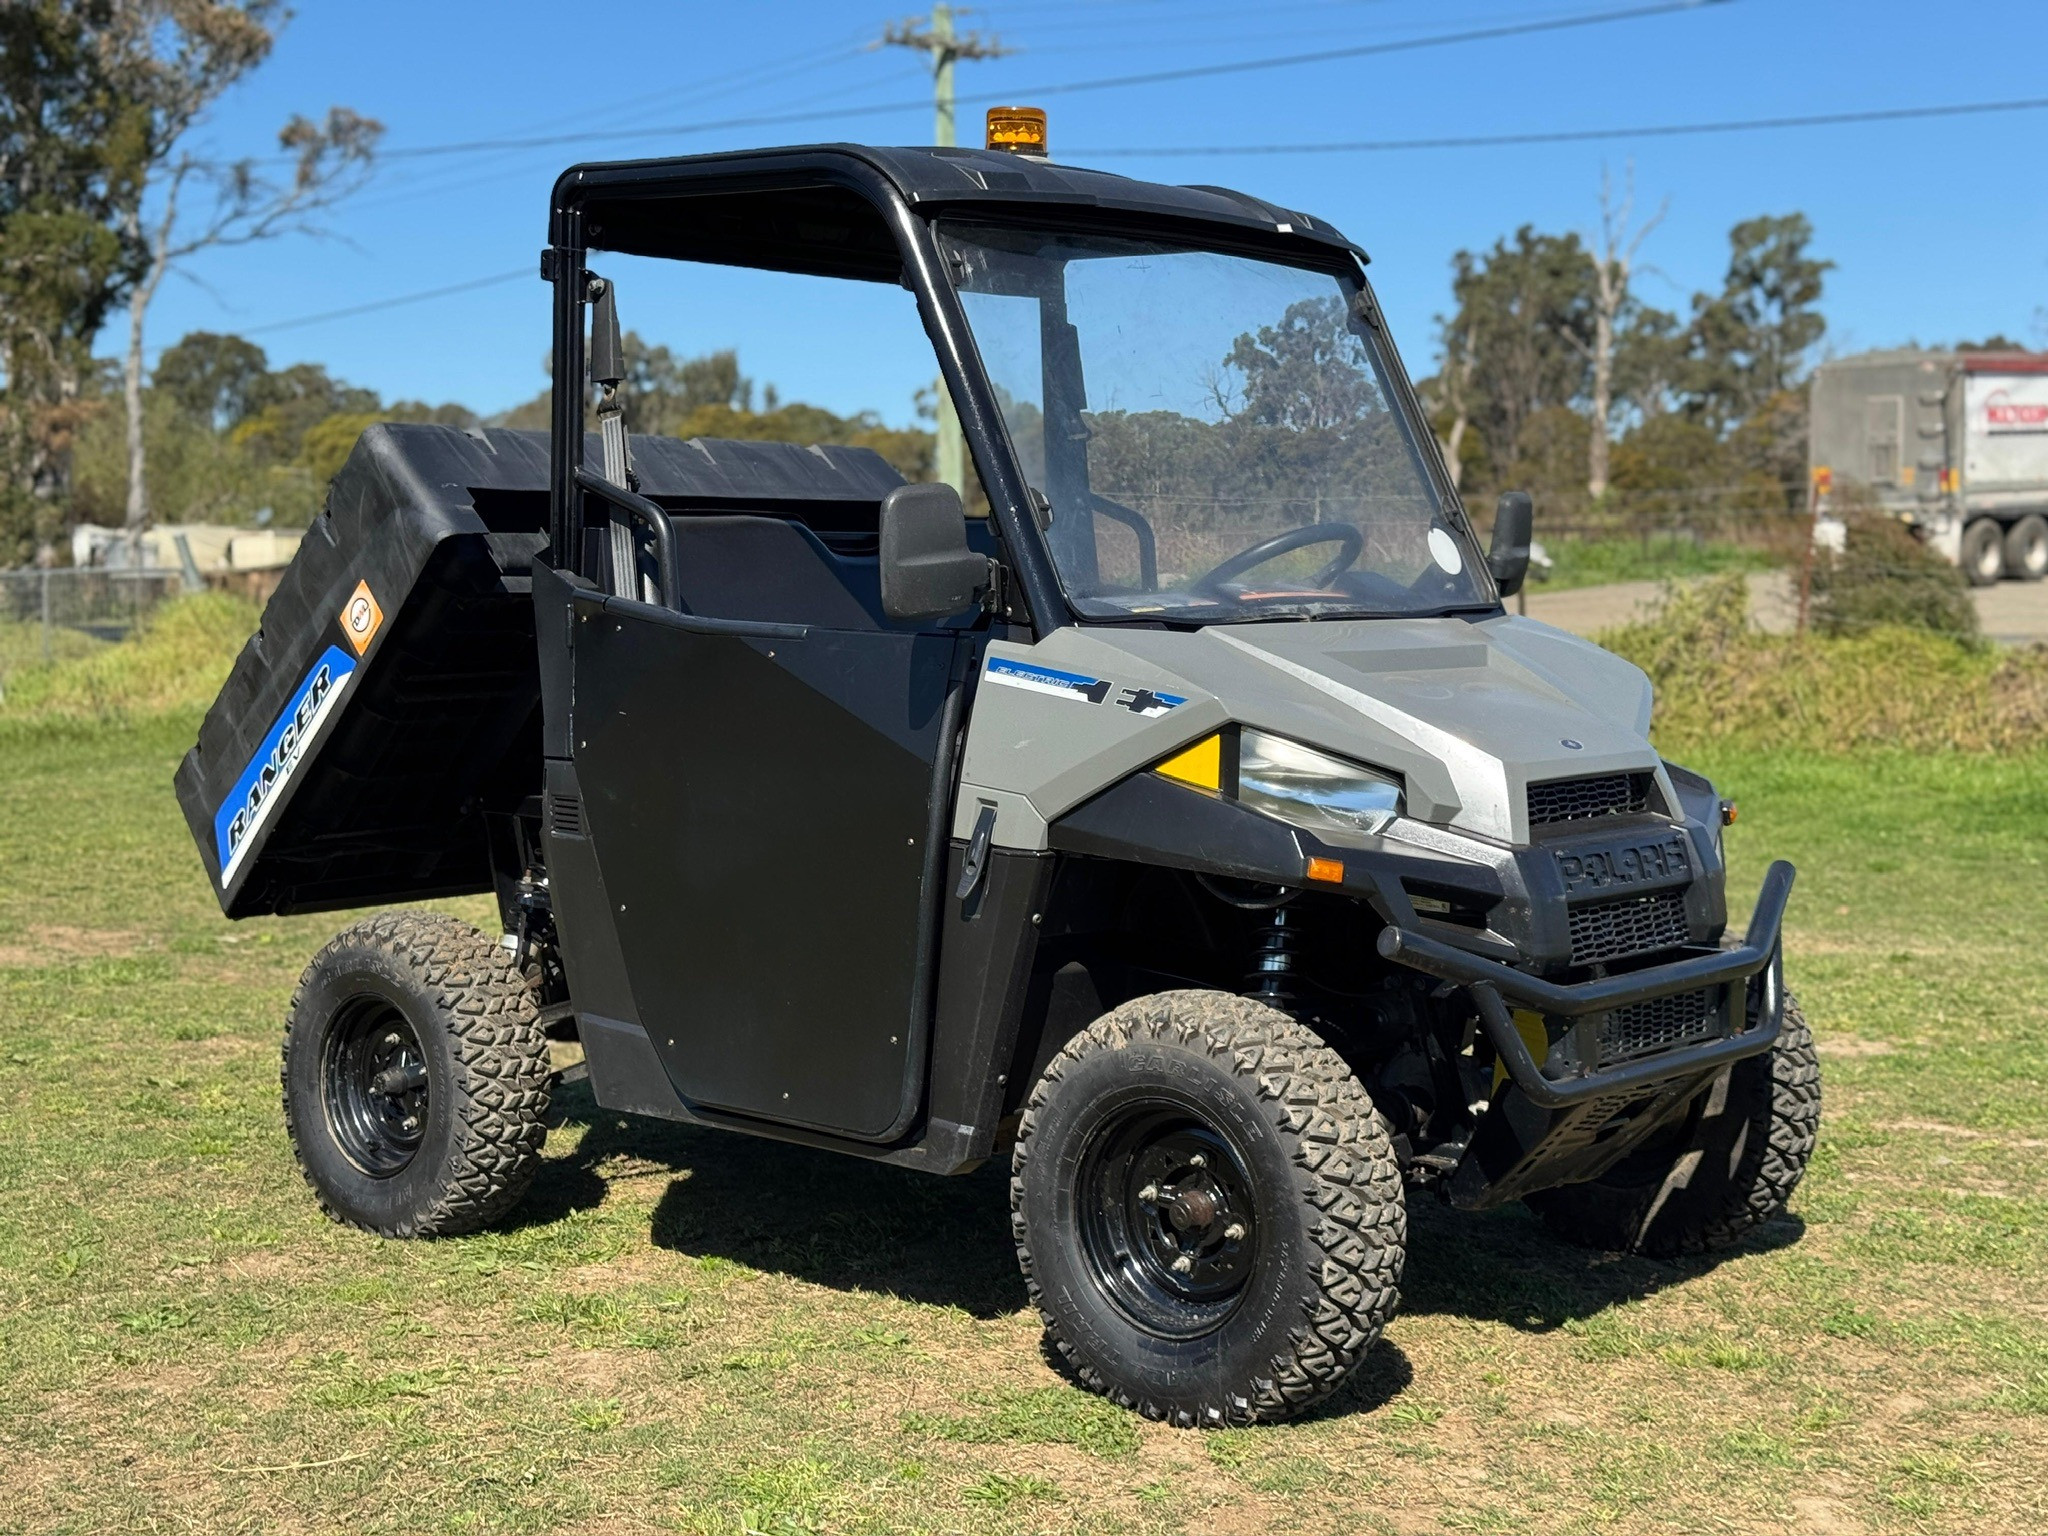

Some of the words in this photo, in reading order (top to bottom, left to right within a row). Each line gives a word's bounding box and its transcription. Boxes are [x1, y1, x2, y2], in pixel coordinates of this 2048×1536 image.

[995, 666, 1072, 690] ELECTRIC
[227, 664, 332, 856] RANGER
[1555, 837, 1688, 893] POLARIS
[1127, 1054, 1264, 1143] CARLISLE
